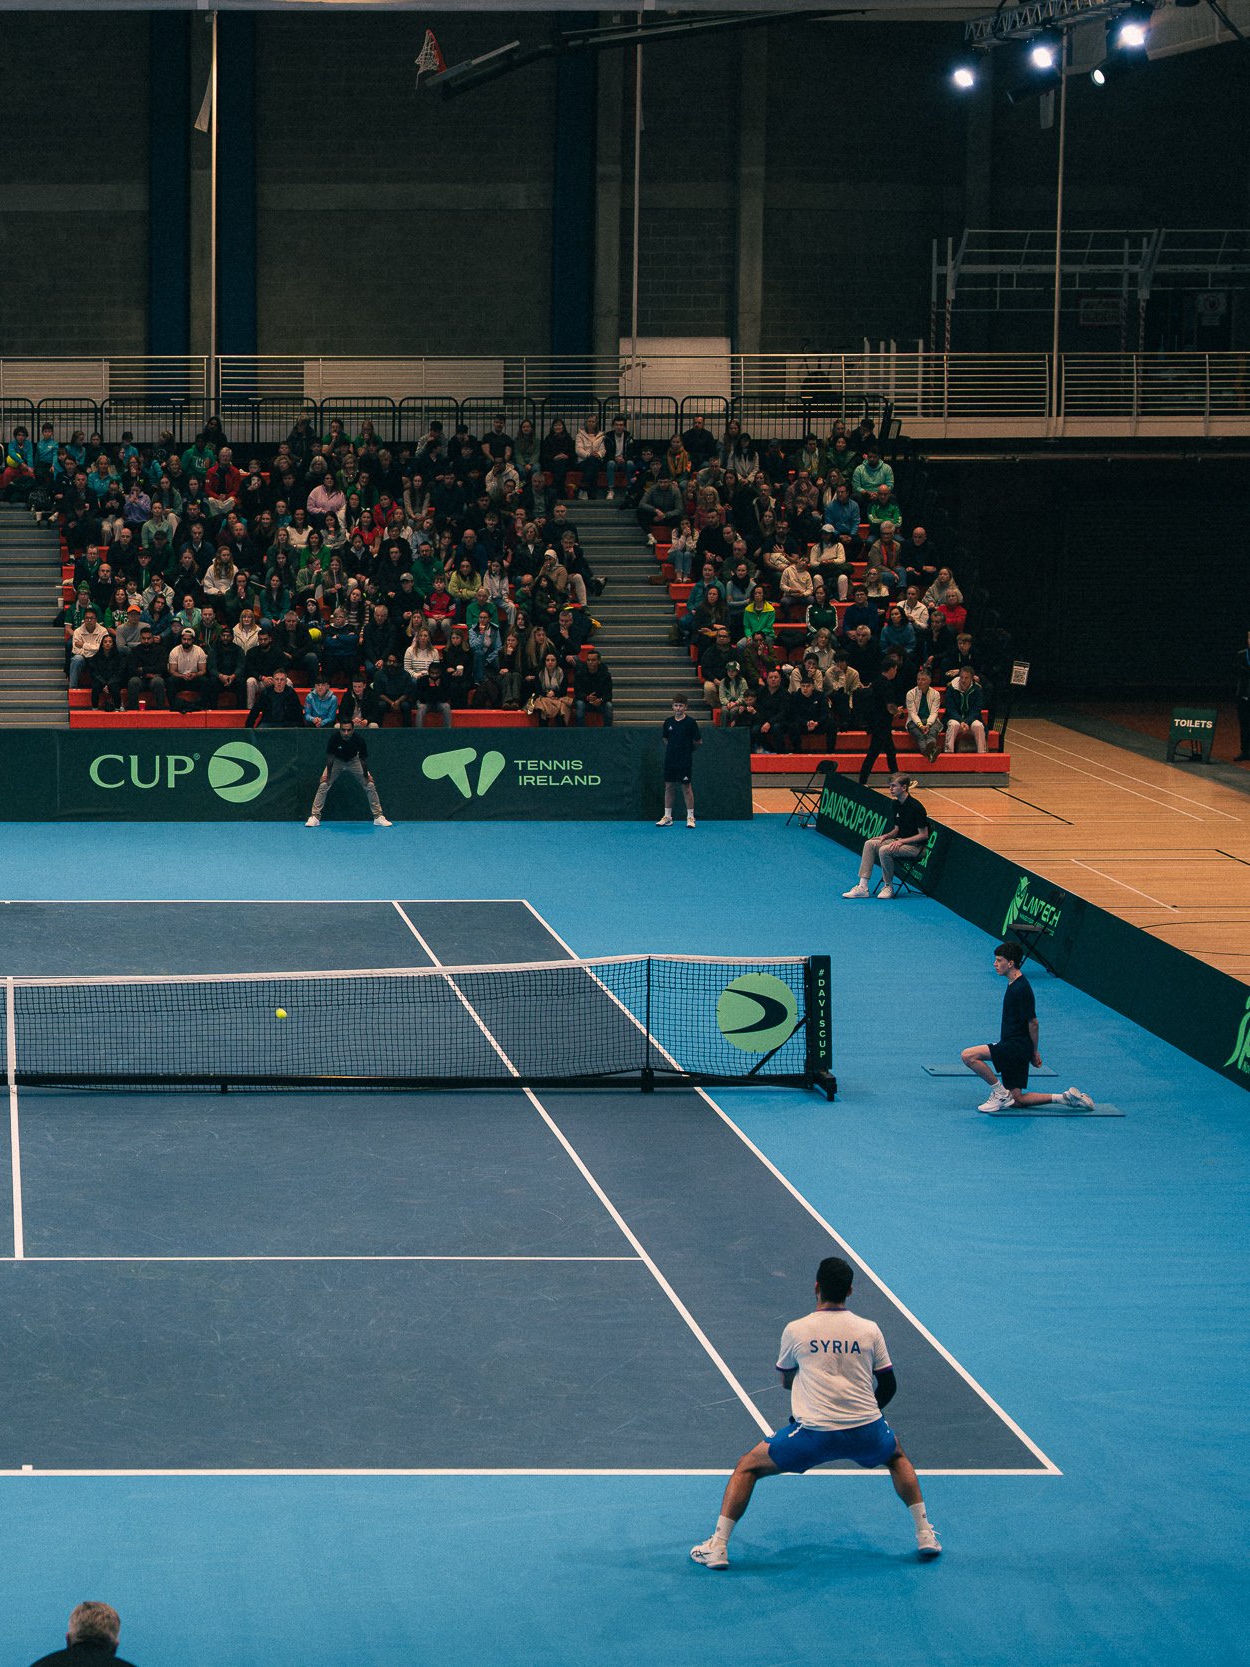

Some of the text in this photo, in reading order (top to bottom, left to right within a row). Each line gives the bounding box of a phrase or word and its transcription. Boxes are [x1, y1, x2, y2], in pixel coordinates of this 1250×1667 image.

[1173, 718, 1213, 729] TOILETS
[513, 760, 584, 771] TENNIS
[518, 775, 601, 786] IRELAND
[820, 787, 888, 839] DAVISCUP.COM
[818, 968, 826, 1058] #DAVISCUP
[809, 1339, 862, 1354] SYRIA
